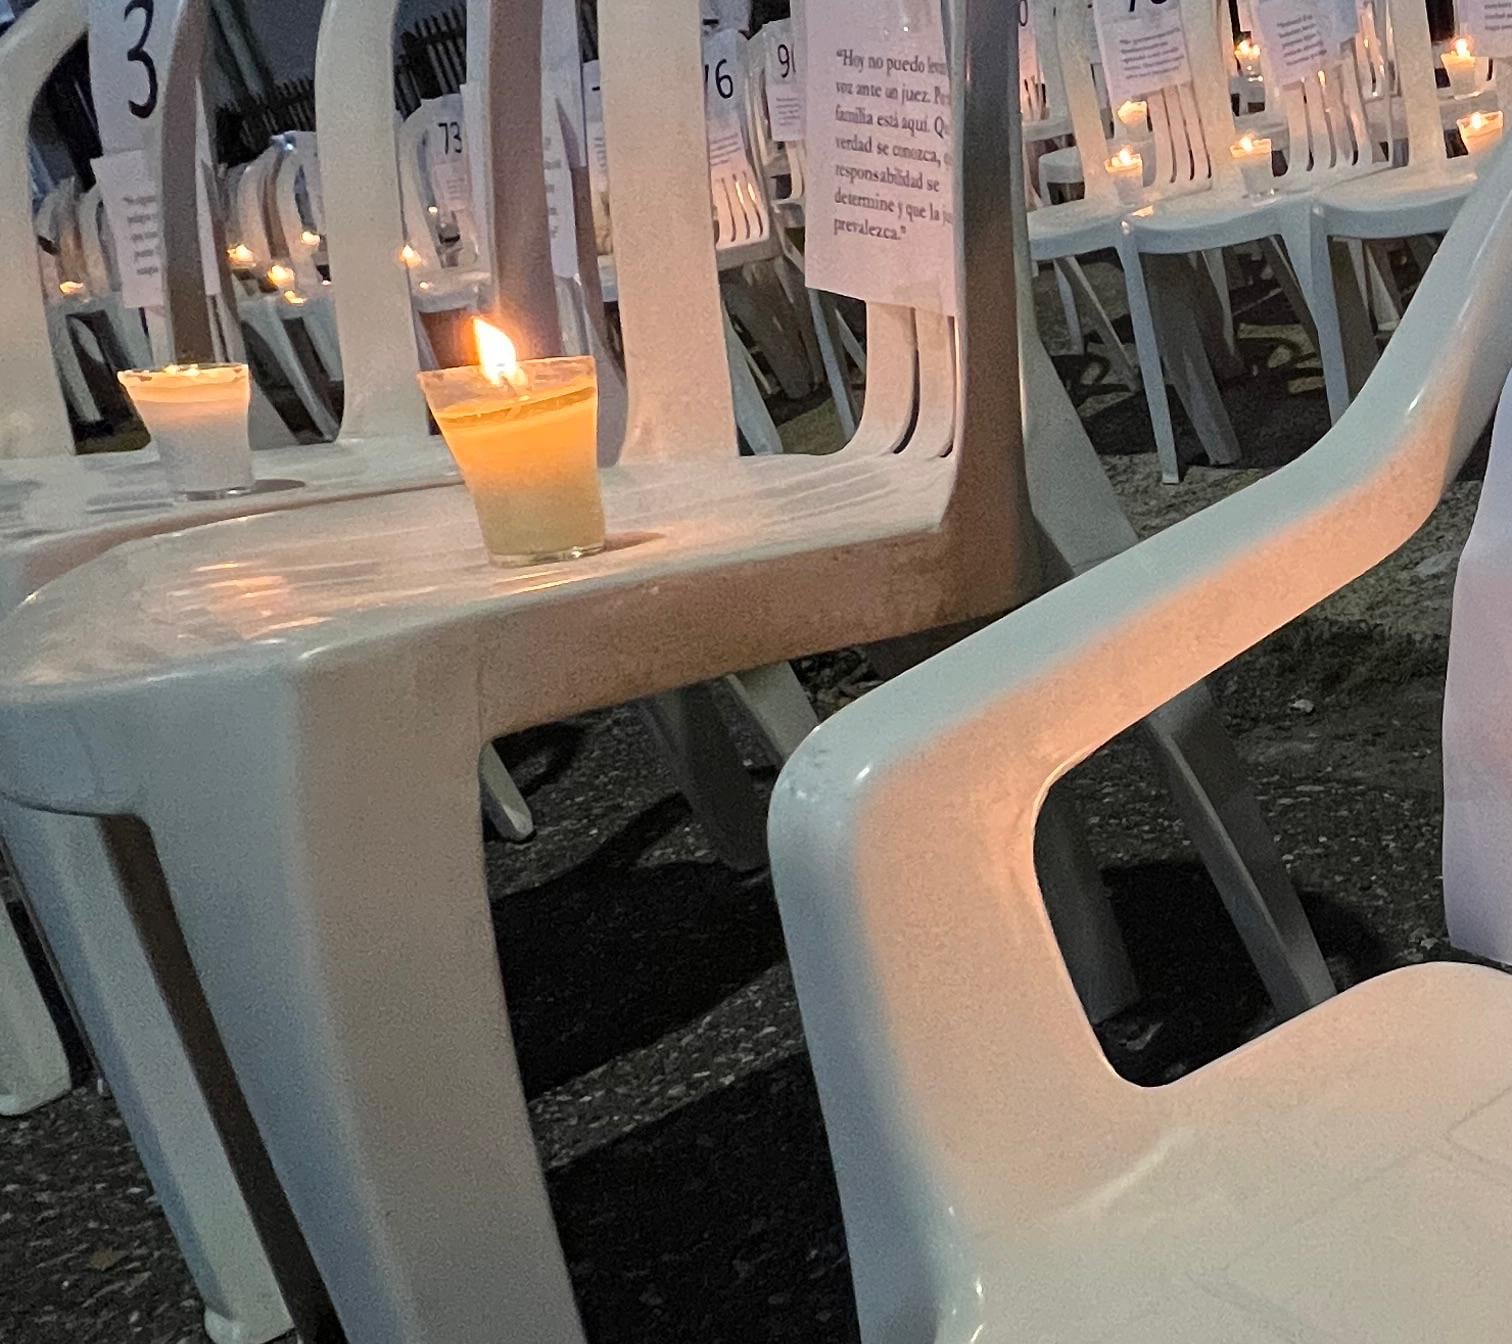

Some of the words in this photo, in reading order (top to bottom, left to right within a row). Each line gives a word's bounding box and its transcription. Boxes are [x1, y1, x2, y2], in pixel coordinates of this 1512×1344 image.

[868, 56, 884, 70] no
[887, 53, 926, 78] puedo
[856, 82, 883, 99] ante
[885, 87, 899, 101] un
[835, 103, 873, 126] familia
[437, 121, 464, 155] 73
[836, 136, 873, 155] verdad
[877, 141, 890, 157] se
[835, 163, 923, 192] responsabilidad
[927, 176, 941, 193] se
[834, 187, 895, 214] determine
[906, 202, 927, 223] que
